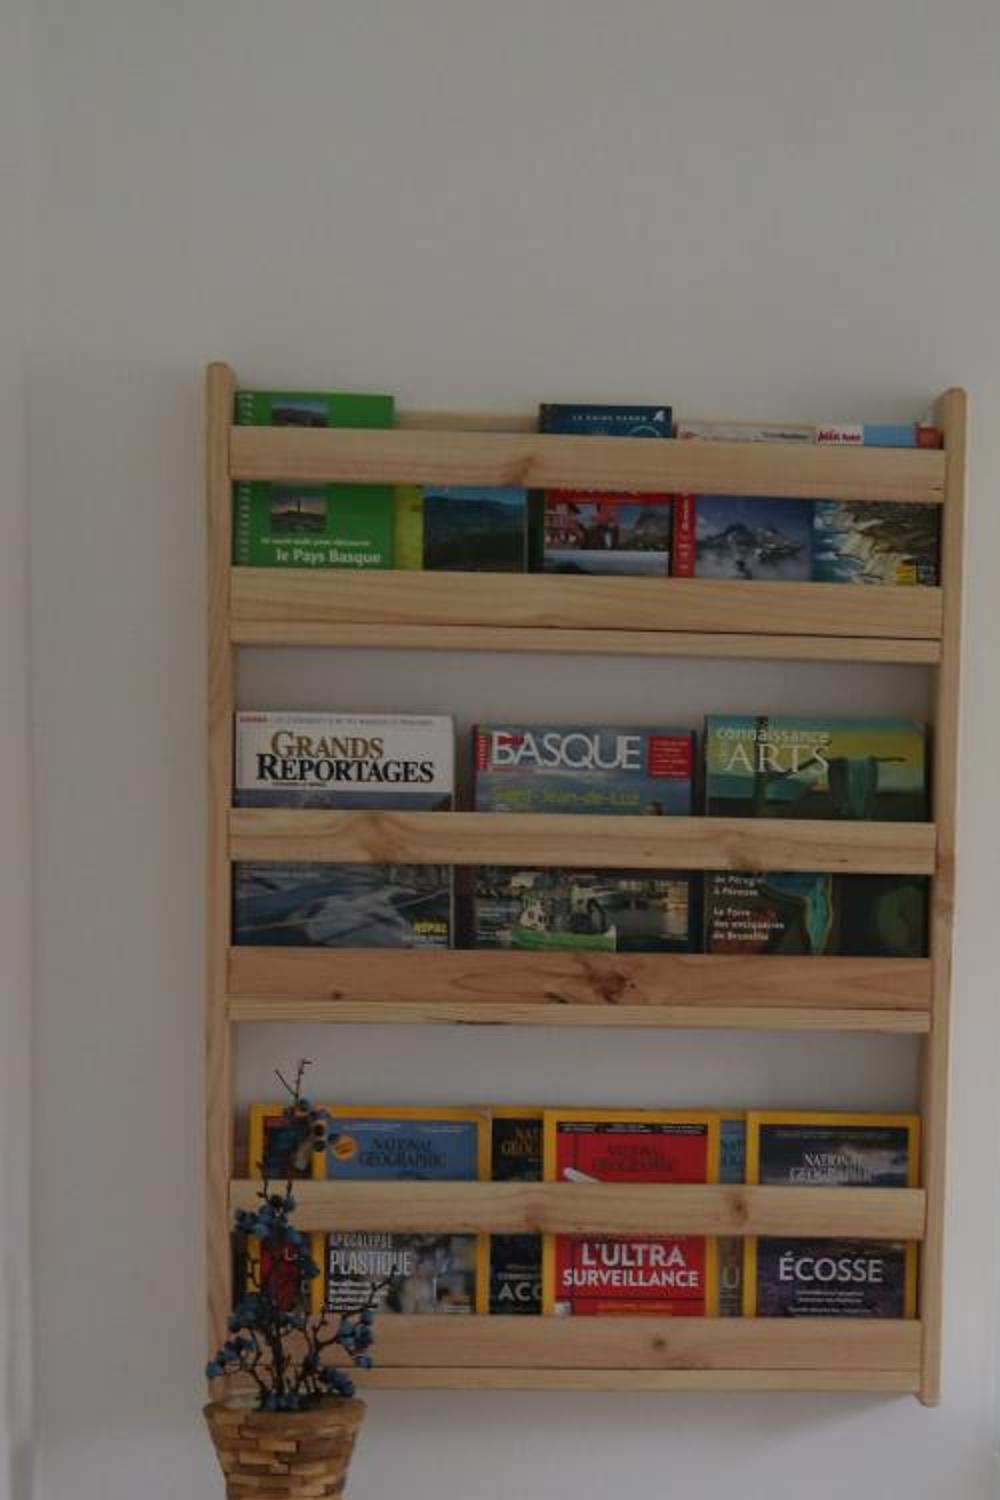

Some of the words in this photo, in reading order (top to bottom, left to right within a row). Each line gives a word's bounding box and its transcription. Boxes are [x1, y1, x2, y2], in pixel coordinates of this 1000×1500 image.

[293, 548, 325, 566] Pays
[329, 549, 382, 567] Basque
[271, 731, 385, 760] GRANDS
[716, 727, 831, 744] connaissance
[491, 731, 641, 769] BASQUE
[724, 742, 831, 776] ARTS
[256, 753, 435, 784] REPORTAGES
[356, 1152, 448, 1170] GEOGRAPHIC
[581, 1242, 687, 1268] L'ULTRA
[779, 1250, 884, 1283] ÉCOSSE
[562, 1268, 699, 1288] SURVEILLANCE
